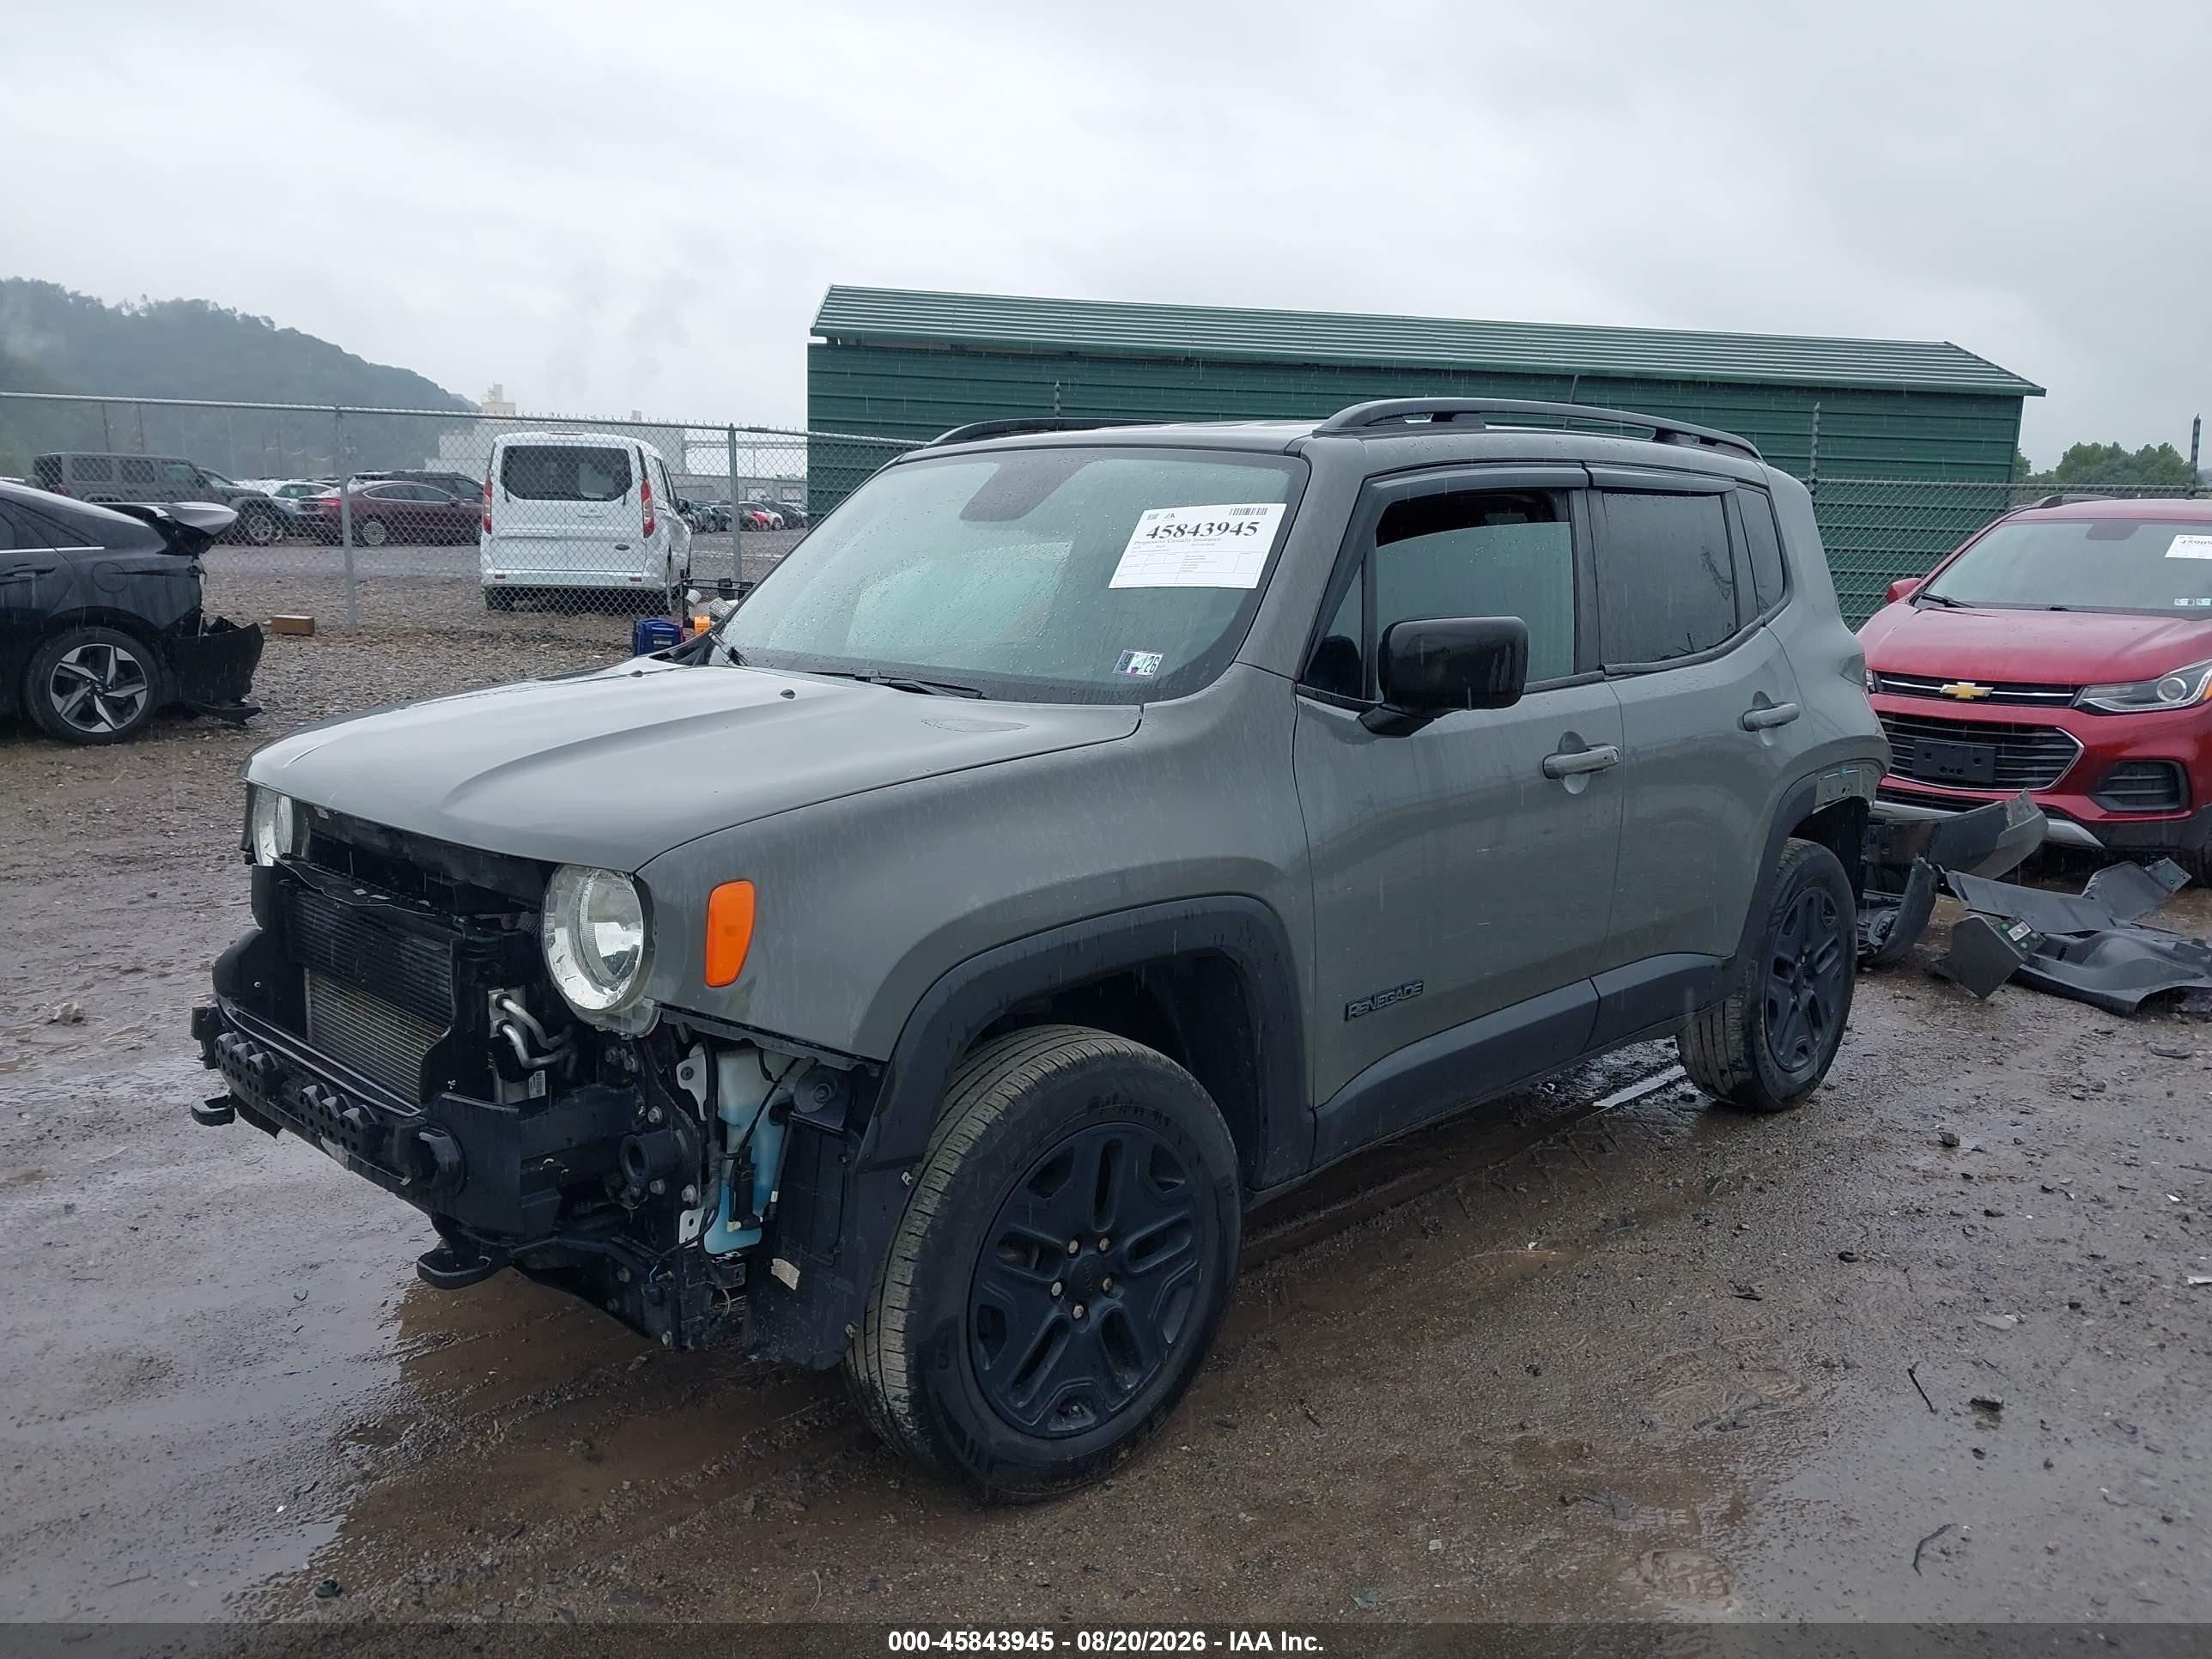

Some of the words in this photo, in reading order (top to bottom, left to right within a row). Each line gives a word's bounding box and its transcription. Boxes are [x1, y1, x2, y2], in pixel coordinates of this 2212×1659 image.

[1146, 521, 1261, 539] 45843945
[1143, 655, 1160, 673] 26
[1344, 980, 1424, 1022] RENEGADE
